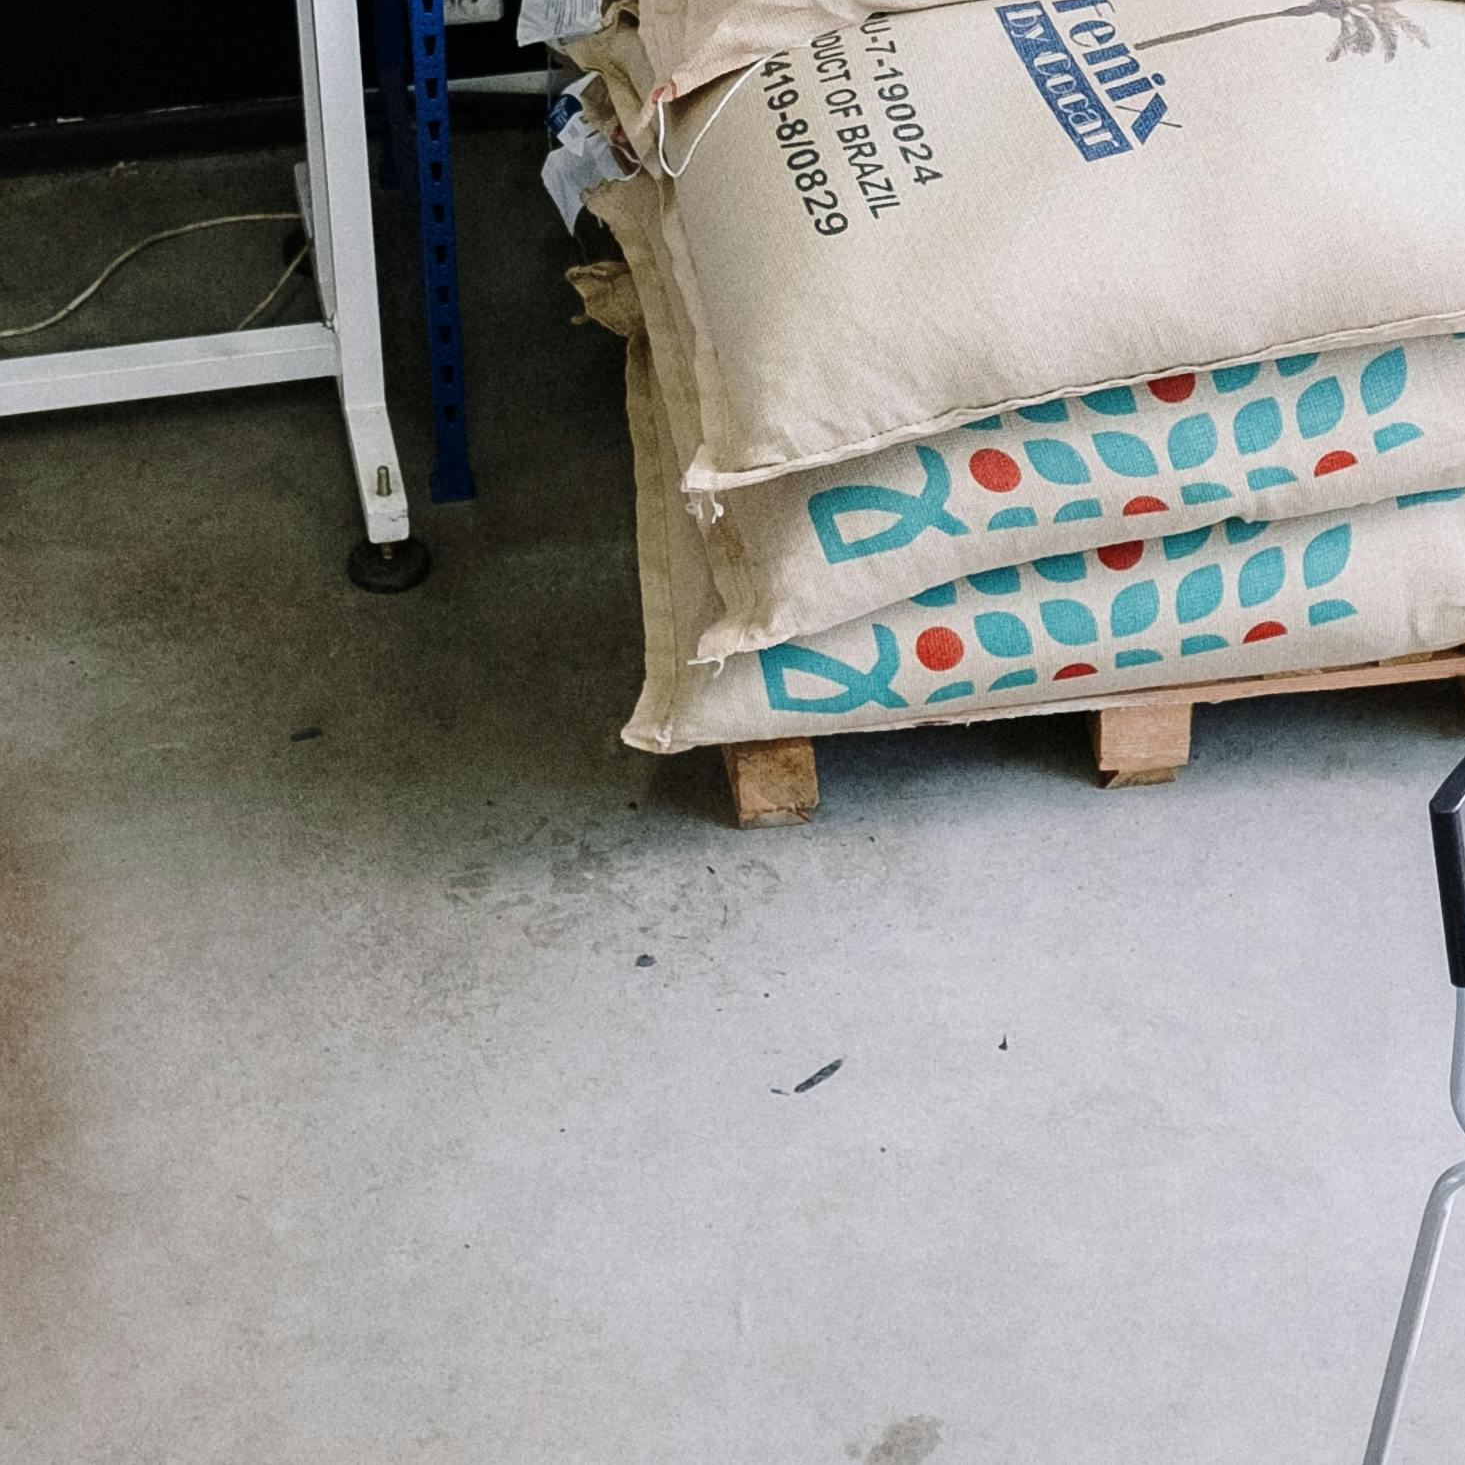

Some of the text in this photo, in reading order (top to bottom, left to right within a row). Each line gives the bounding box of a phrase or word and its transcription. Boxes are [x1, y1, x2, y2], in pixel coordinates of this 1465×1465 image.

[1005, 5, 1052, 45] by
[824, 86, 863, 122] OF
[859, 15, 944, 187] U-7-190024
[836, 123, 901, 221] BRAZIL
